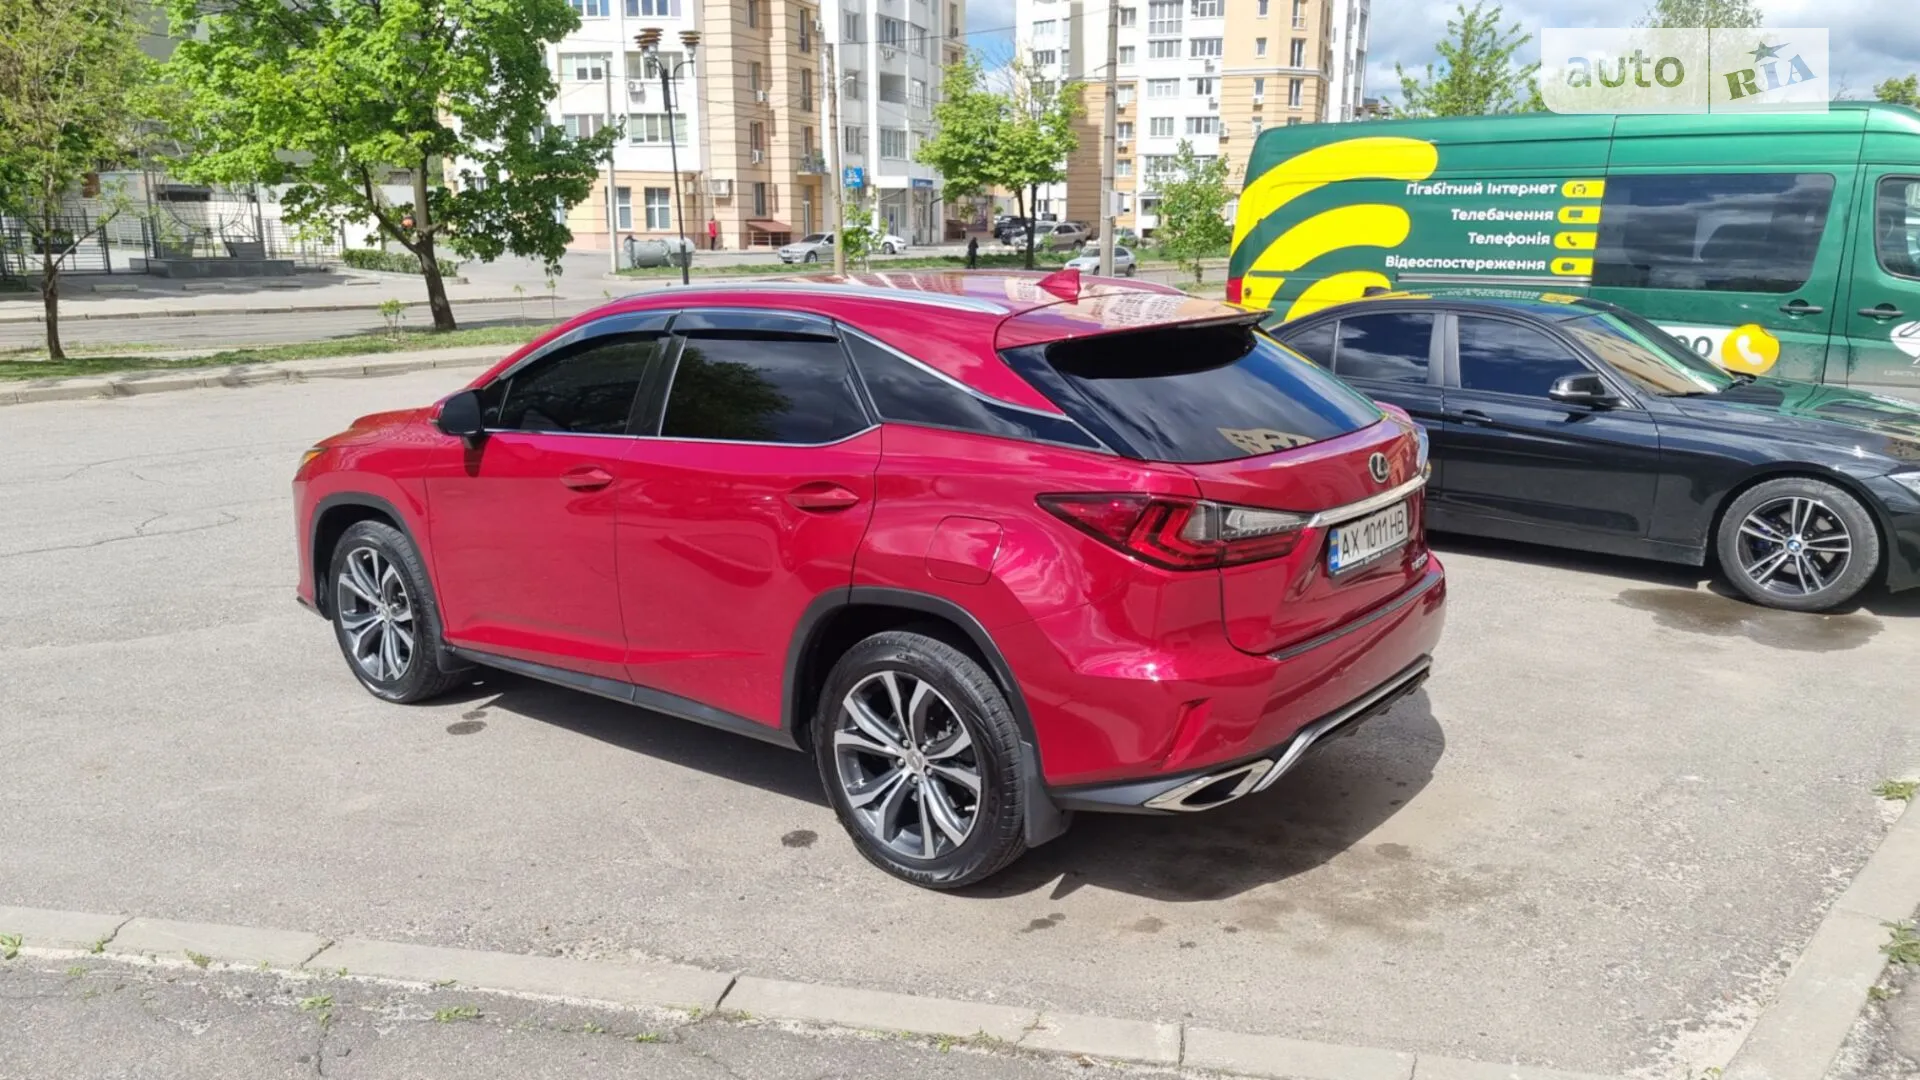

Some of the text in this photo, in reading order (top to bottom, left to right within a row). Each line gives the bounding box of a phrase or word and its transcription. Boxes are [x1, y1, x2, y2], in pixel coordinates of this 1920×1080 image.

[1406, 181, 1558, 197] Гігабітний Інтернет
[1451, 208, 1554, 221] Телебачення
[1468, 231, 1551, 247] Телефонія
[1385, 255, 1546, 271] Відеоспостереження
[1341, 527, 1360, 561] AX
[1363, 517, 1388, 551] 1011
[1389, 510, 1404, 540] HB
